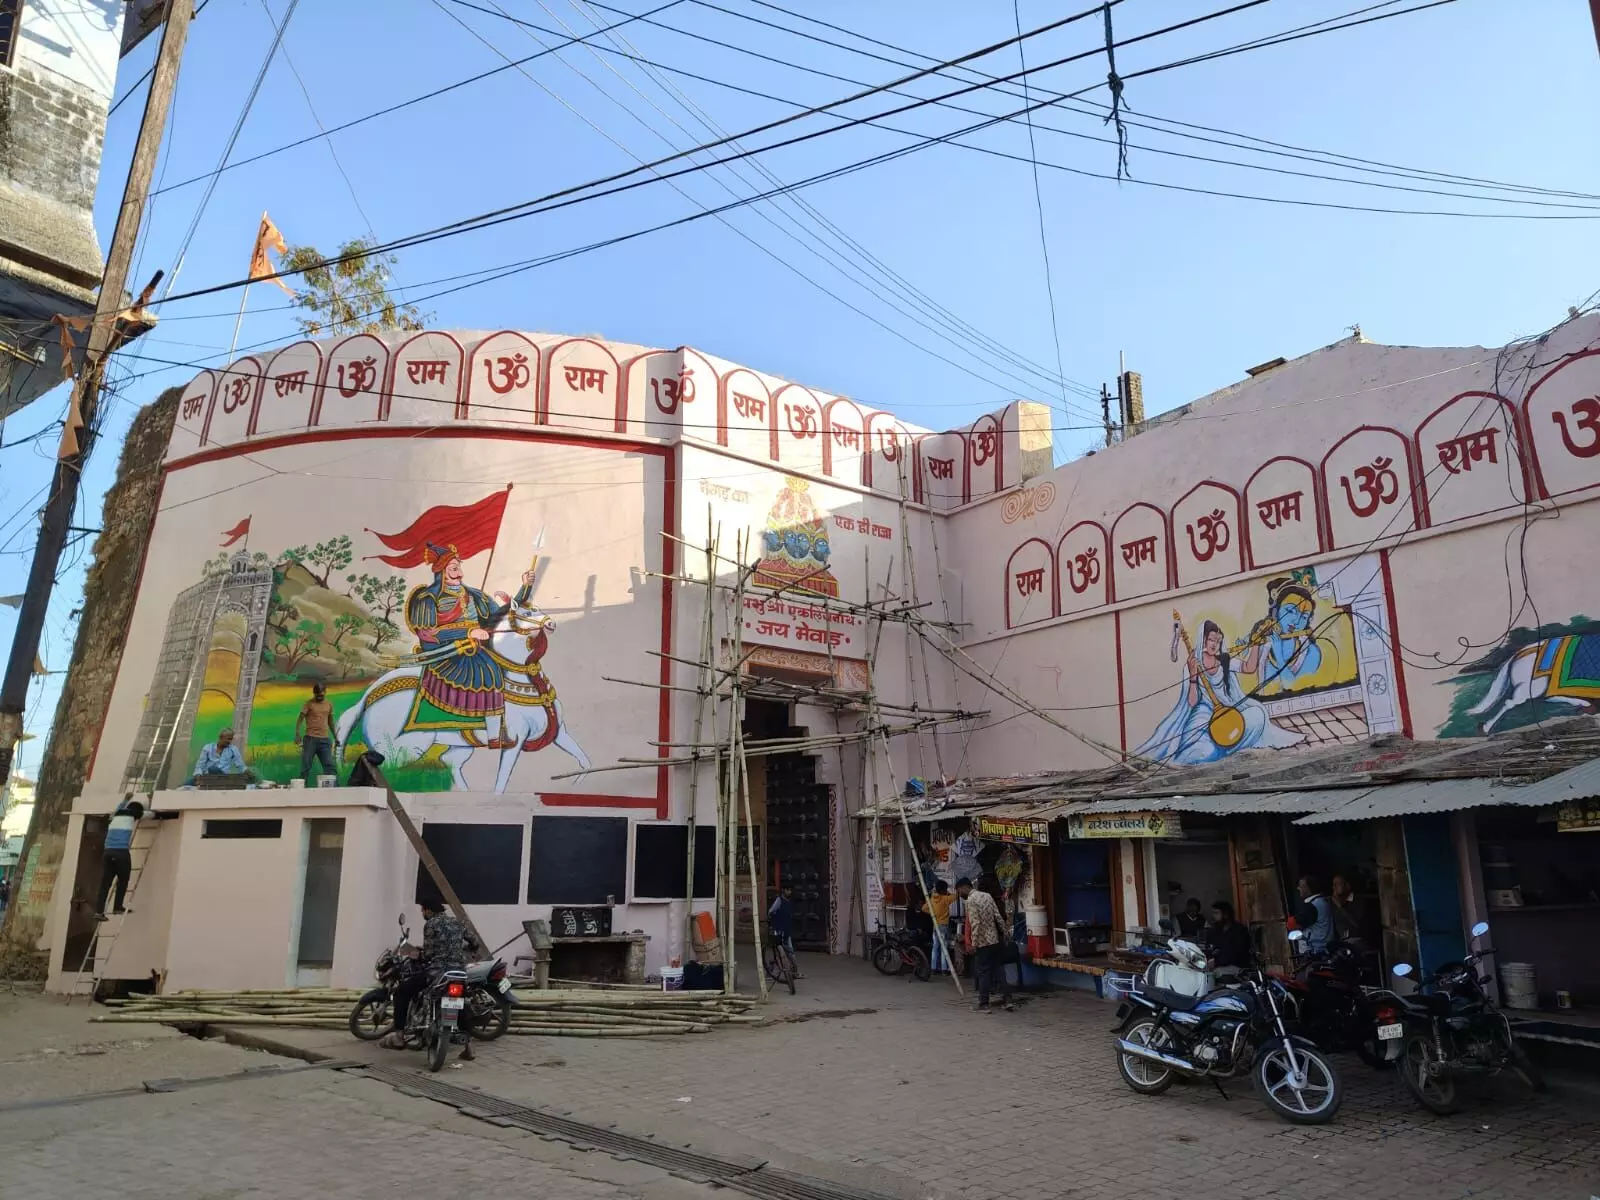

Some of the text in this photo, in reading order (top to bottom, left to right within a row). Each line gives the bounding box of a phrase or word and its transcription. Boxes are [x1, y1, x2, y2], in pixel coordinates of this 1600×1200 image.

[182, 352, 696, 420] राम ॐ राम ॐ राम ॐ राम ॐ
[732, 390, 767, 423] राम
[784, 403, 817, 440] ॐ
[831, 421, 861, 451] राम
[927, 425, 997, 480] राम ॐ
[833, 514, 893, 541] एक ही राजा
[1015, 567, 1045, 598] राम
[1067, 546, 1101, 594] ॐ
[1120, 535, 1158, 569] राम
[1186, 508, 1230, 562] ॐ
[1256, 491, 1304, 530] राम
[1340, 455, 1399, 518] ॐ
[1435, 427, 1501, 475] राम
[755, 619, 845, 649] जय मेवाड़
[766, 599, 784, 614] श्री
